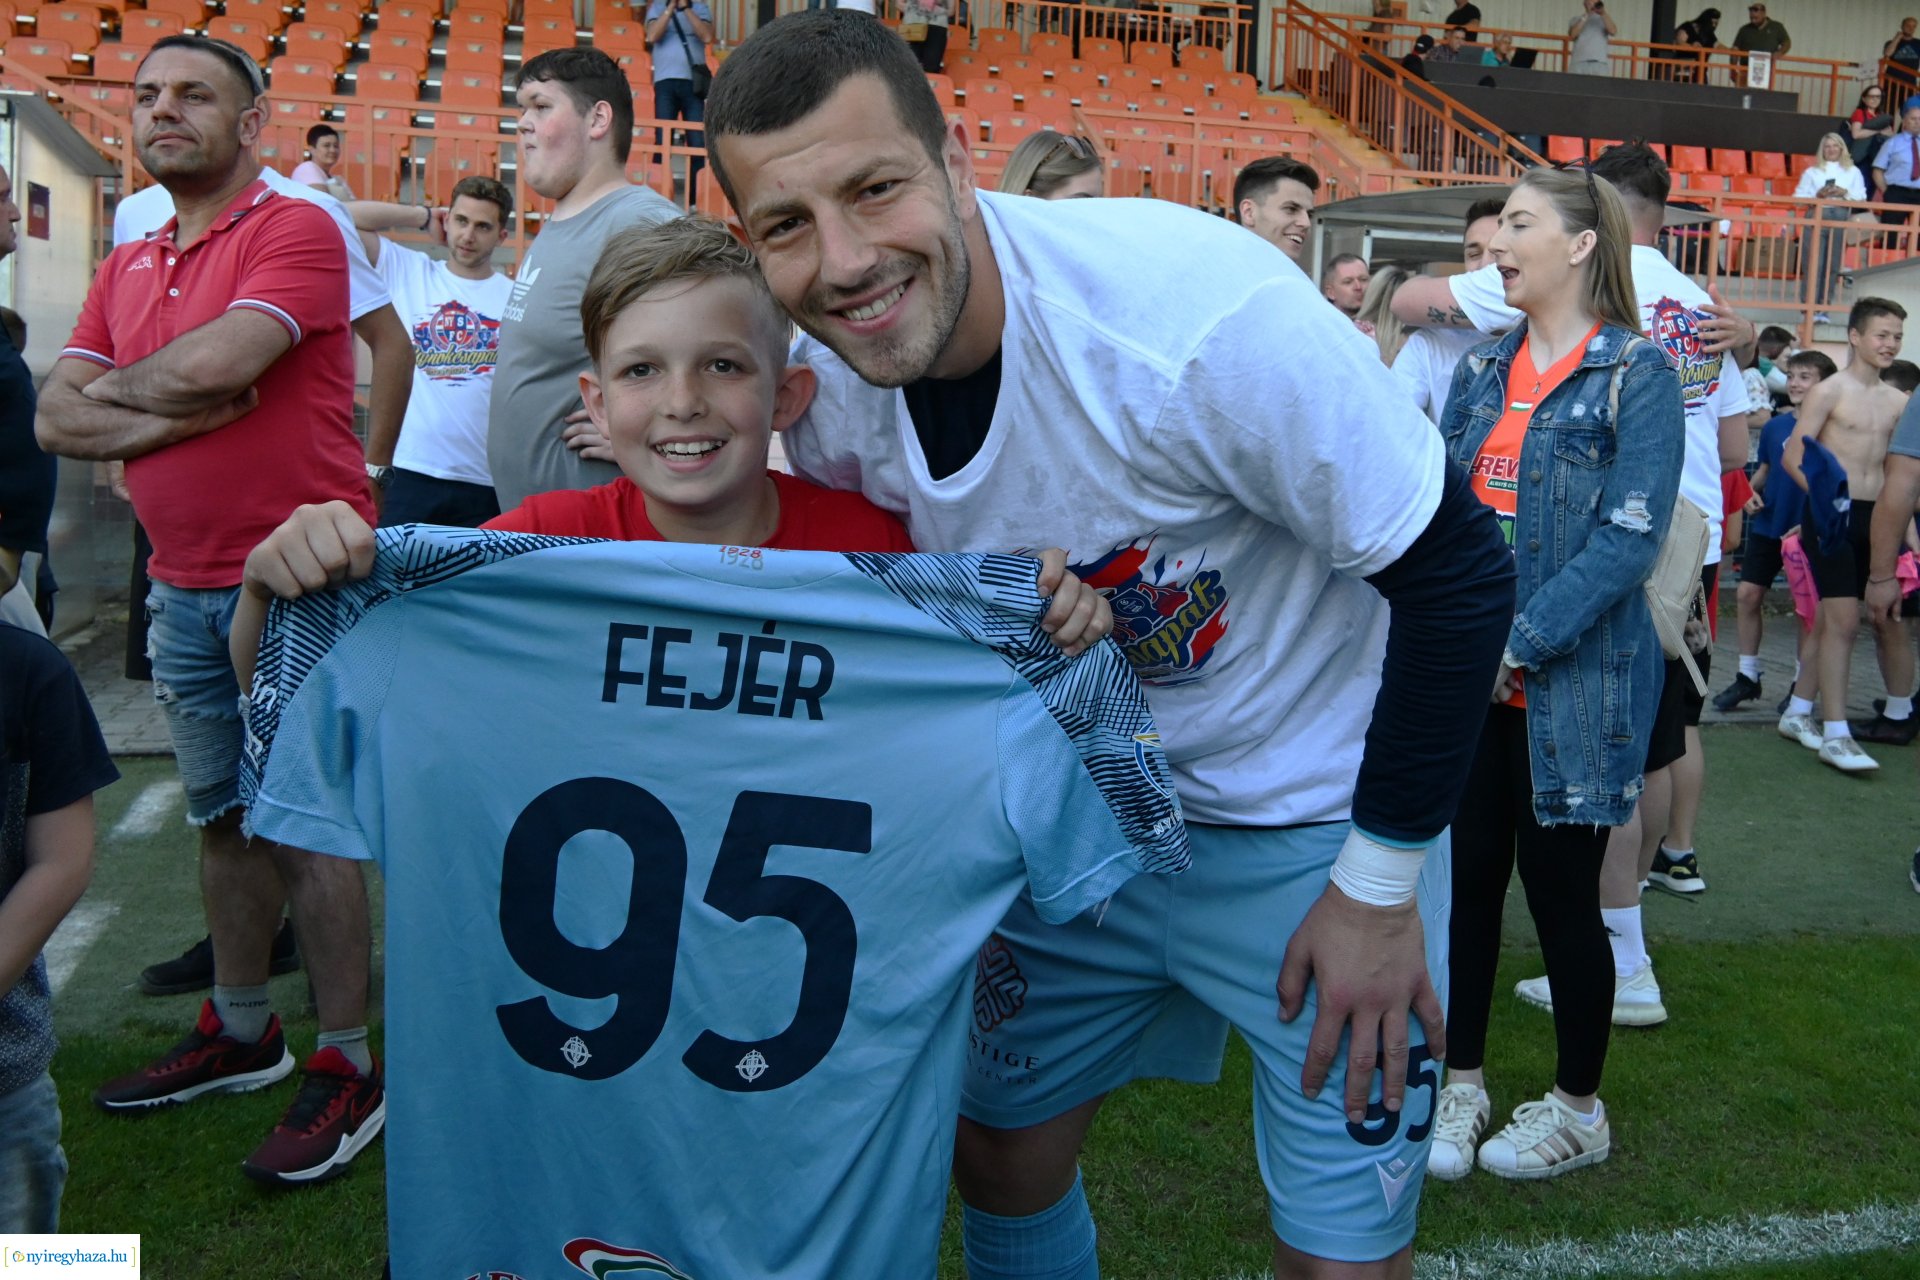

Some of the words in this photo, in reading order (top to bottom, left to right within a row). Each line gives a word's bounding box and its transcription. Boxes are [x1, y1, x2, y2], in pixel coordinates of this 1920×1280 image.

[601, 620, 835, 721] FEJÉR
[496, 776, 872, 1093] 95
[969, 1031, 1040, 1072] STIGE
